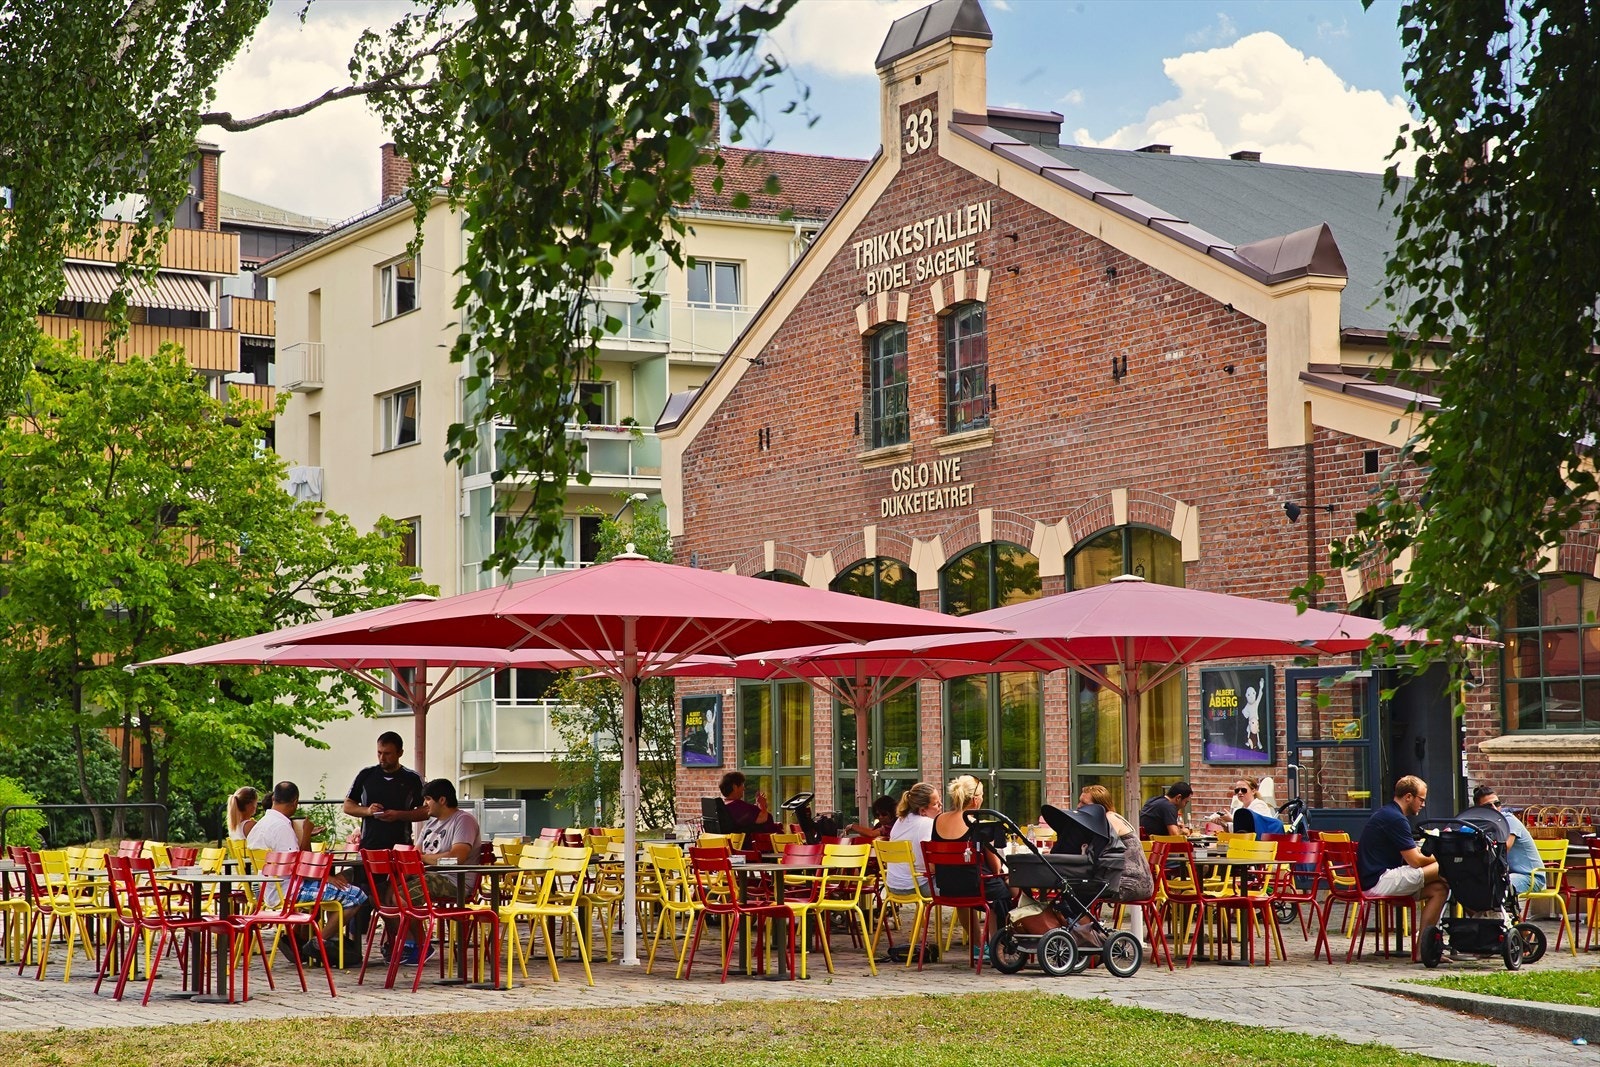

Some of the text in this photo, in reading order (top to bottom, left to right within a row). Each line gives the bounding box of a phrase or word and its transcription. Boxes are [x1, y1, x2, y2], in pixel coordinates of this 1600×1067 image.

[905, 108, 933, 155] 33
[852, 200, 991, 270] TRIKKESTALLEN
[866, 241, 976, 296] BYDEL SAGENE
[891, 456, 962, 492] OSLO NYE
[881, 483, 975, 518] DUKKETEATRET
[1209, 693, 1238, 707] ÅBERG
